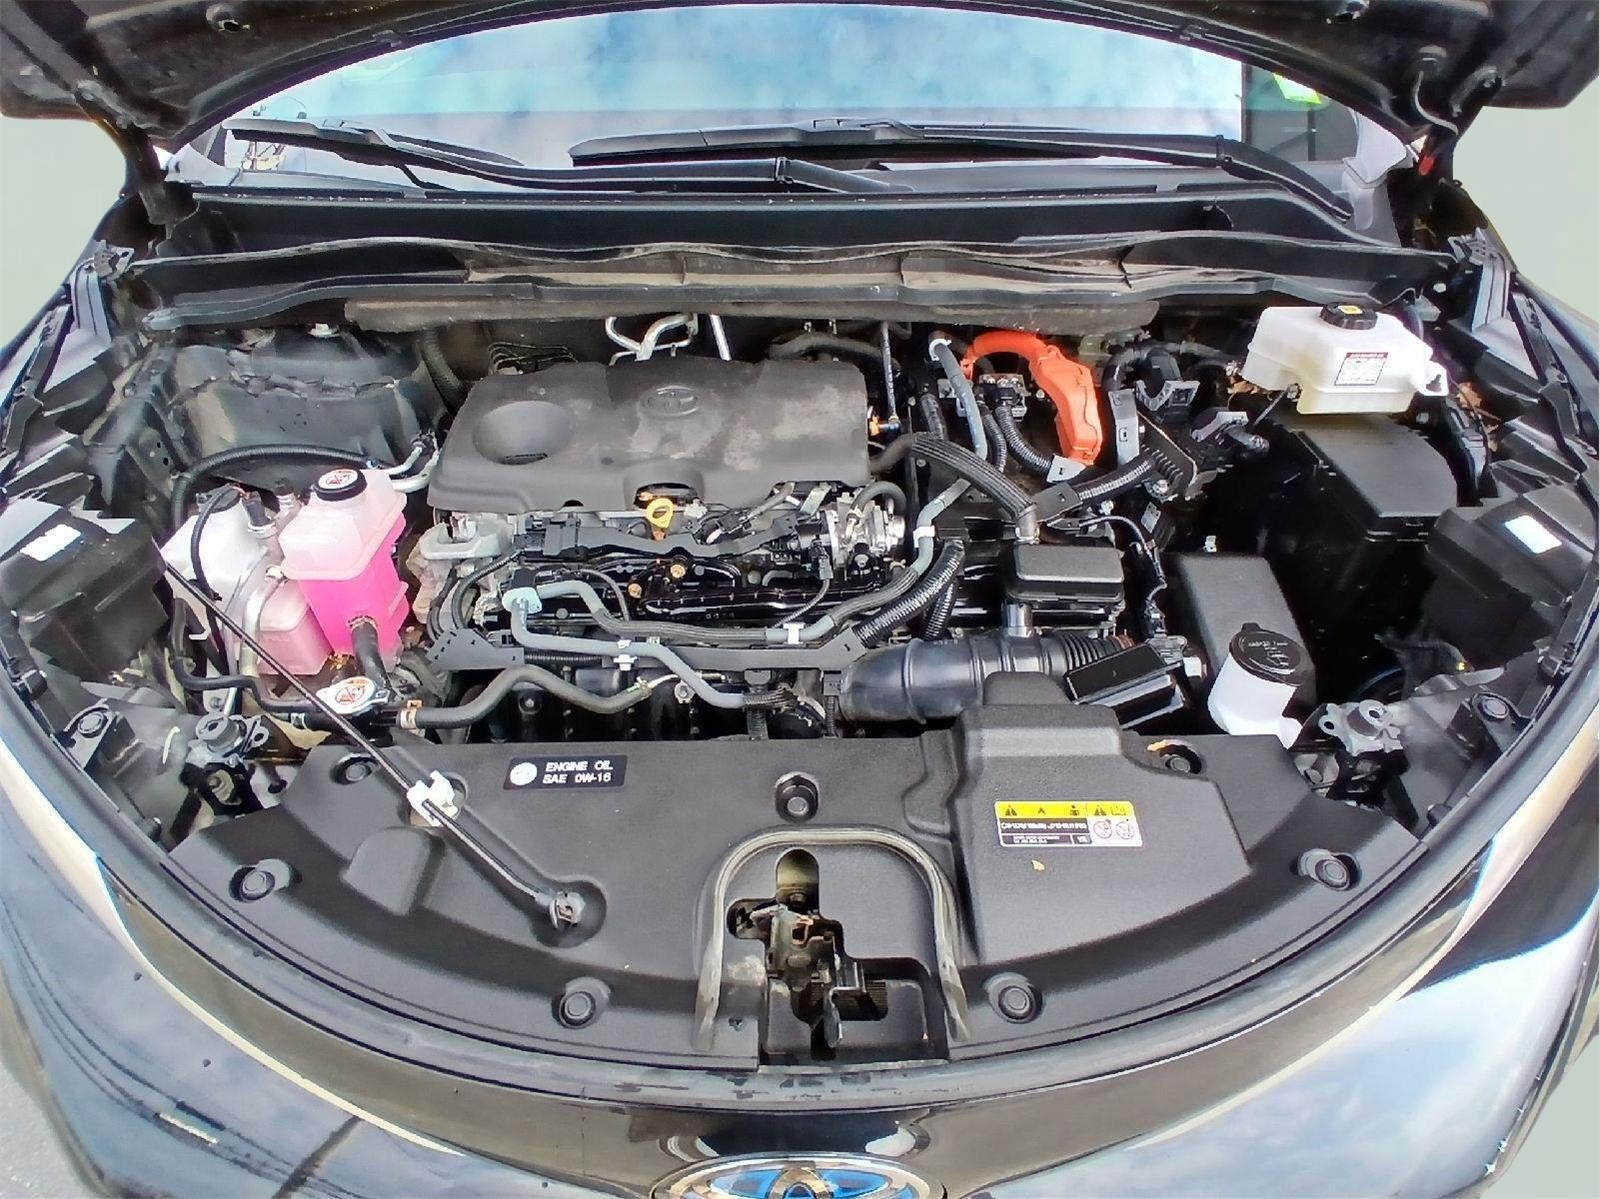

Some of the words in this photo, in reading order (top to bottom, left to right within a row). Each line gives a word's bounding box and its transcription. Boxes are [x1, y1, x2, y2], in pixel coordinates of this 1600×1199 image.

[545, 761, 588, 772] ENGINE
[594, 760, 613, 770] OIL
[542, 774, 567, 784] SAE
[574, 772, 611, 783] 0W-16
